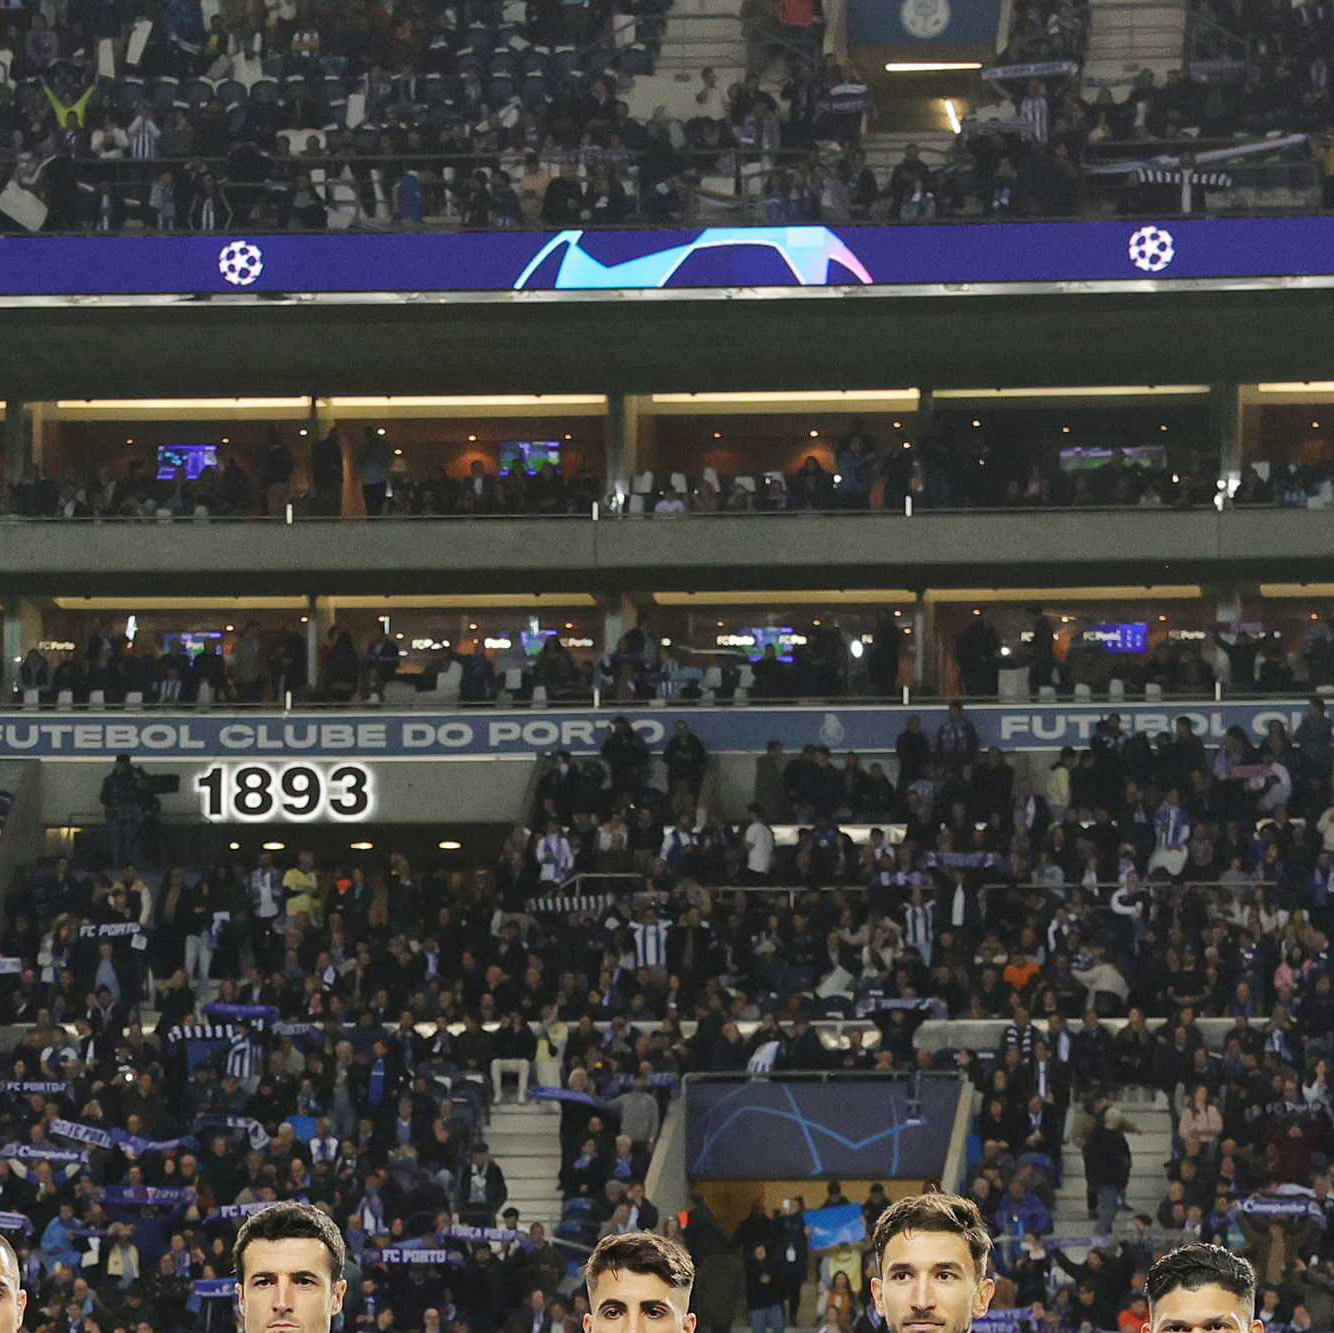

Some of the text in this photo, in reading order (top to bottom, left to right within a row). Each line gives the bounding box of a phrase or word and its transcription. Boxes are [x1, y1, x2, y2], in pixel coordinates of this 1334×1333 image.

[217, 721, 387, 749] CLUBE
[401, 720, 474, 748] DO
[488, 718, 665, 747] PORO
[197, 766, 369, 816] 1893
[79, 925, 97, 938] FC
[7, 1082, 21, 1092] FC
[382, 1250, 446, 1263] FC PORTO
